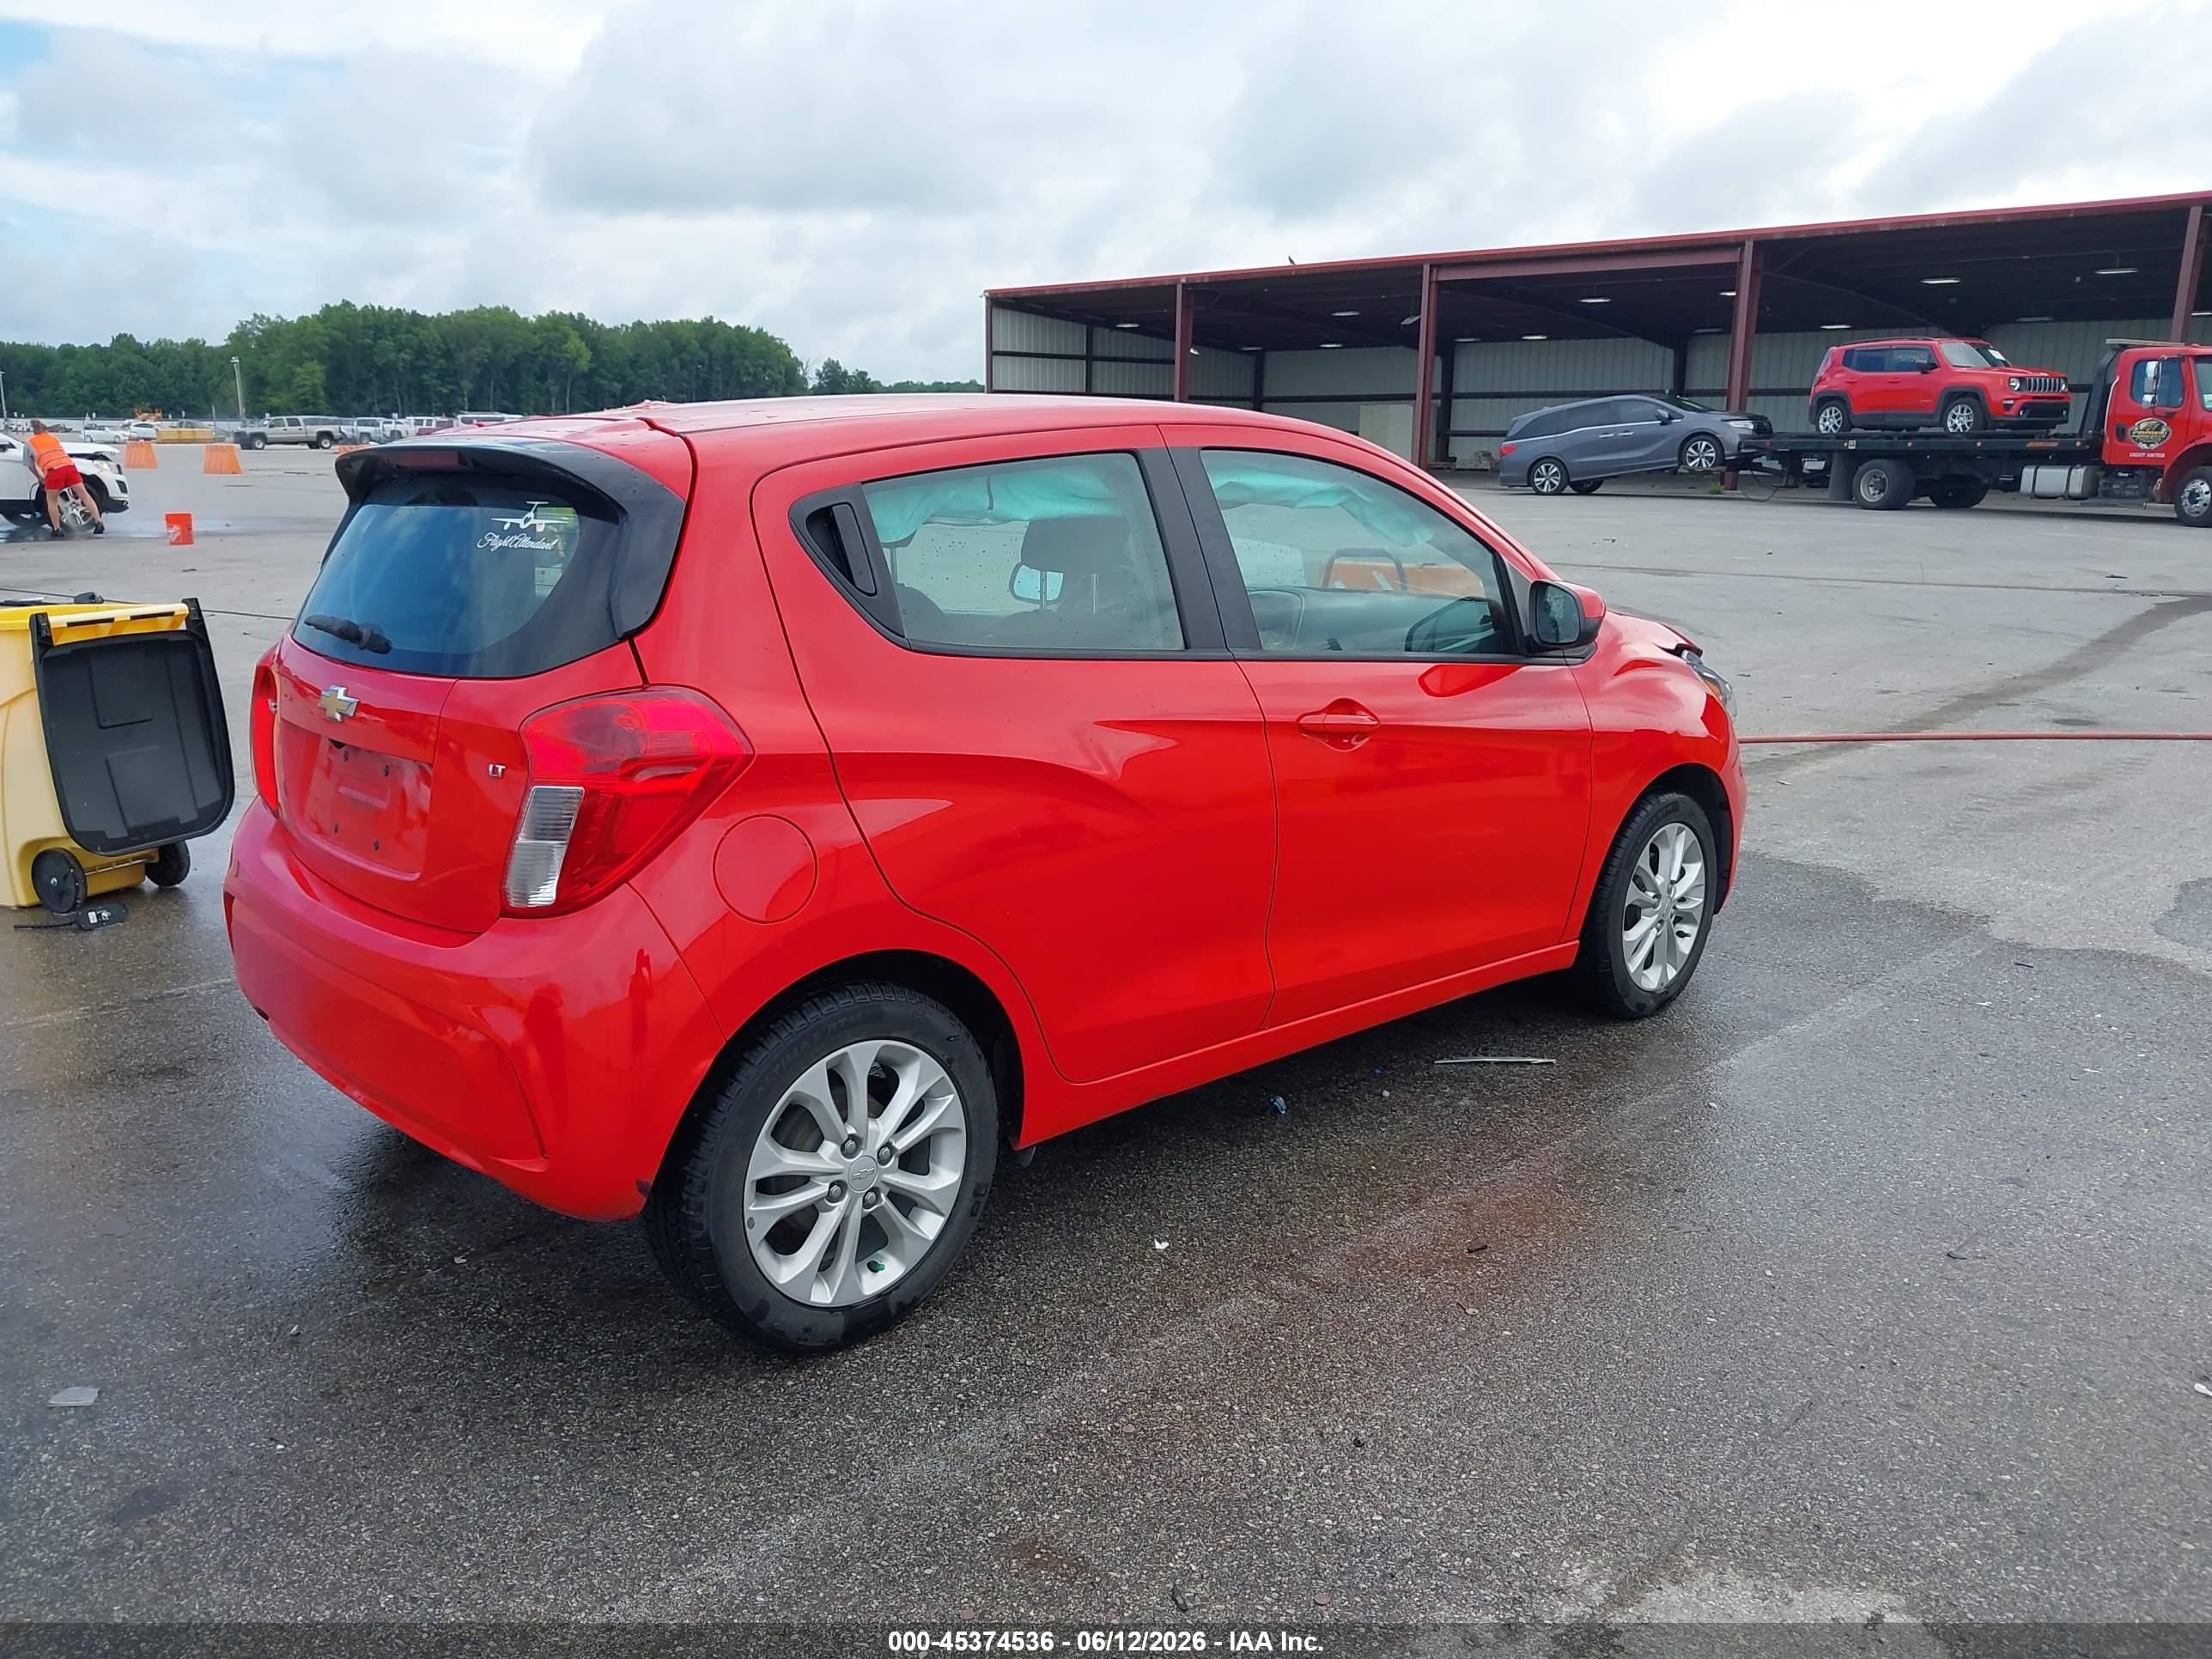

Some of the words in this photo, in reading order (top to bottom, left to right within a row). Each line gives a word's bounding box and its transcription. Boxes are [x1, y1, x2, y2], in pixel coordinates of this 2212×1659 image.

[477, 532, 513, 552] Flight
[509, 532, 558, 550] Attendant
[489, 763, 506, 778] LT
